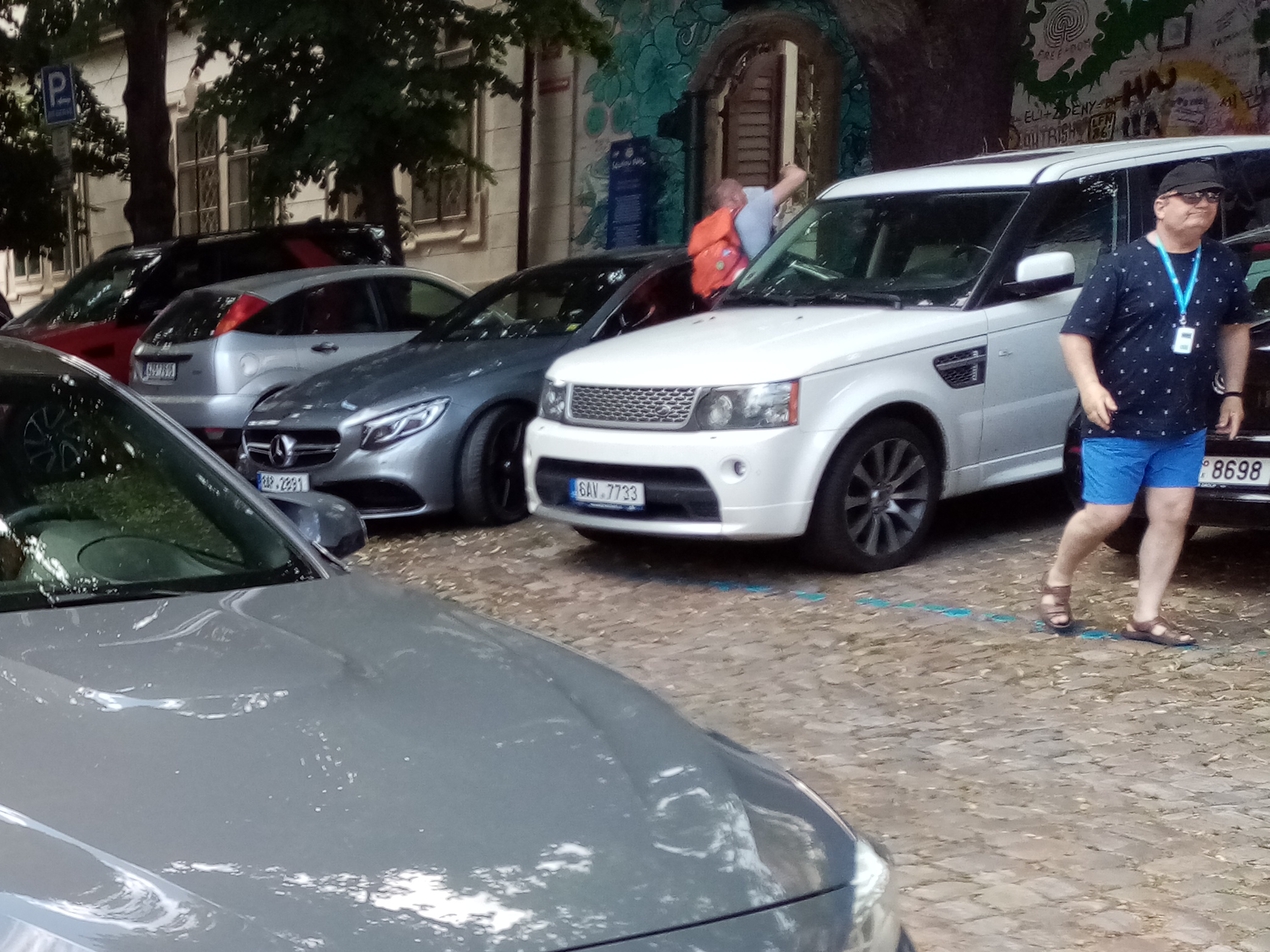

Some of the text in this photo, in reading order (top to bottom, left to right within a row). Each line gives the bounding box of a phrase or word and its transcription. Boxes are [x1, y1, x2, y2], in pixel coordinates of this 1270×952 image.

[48, 71, 67, 108] P
[1212, 459, 1262, 481] 8698
[607, 483, 638, 501] 7733
